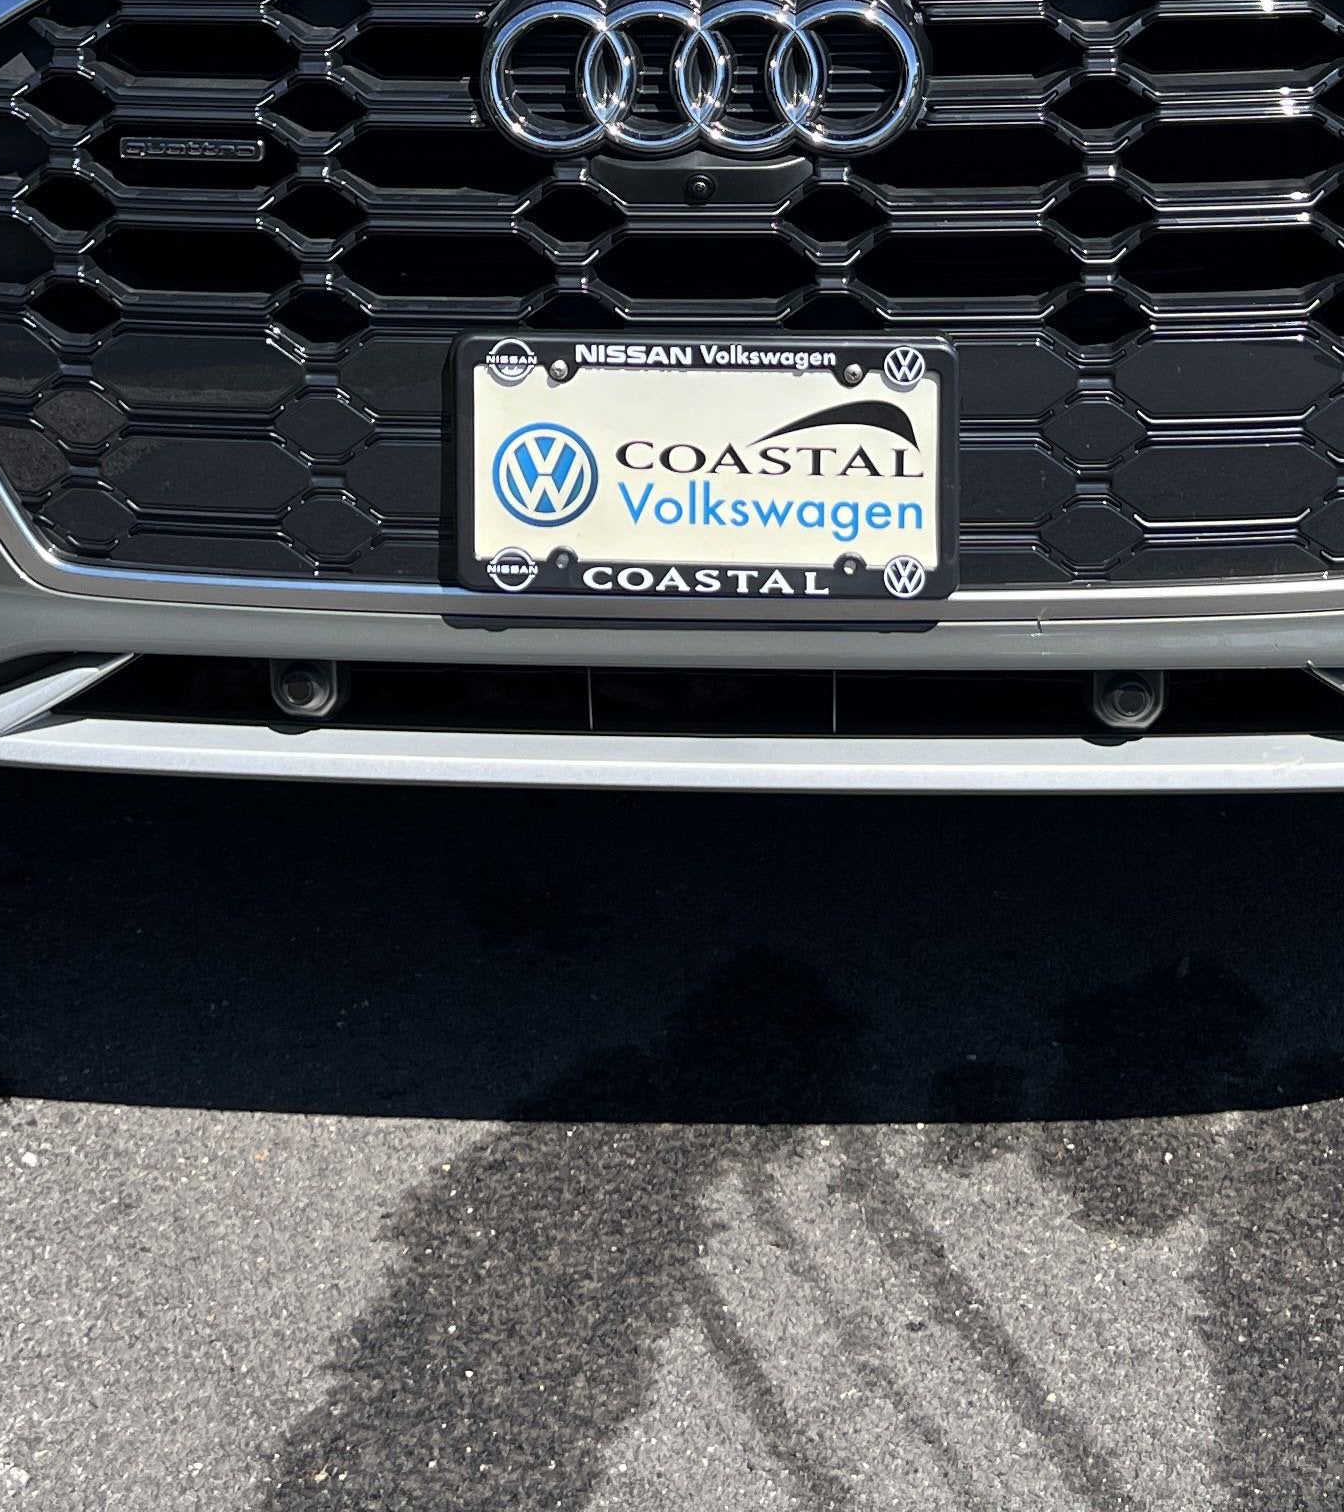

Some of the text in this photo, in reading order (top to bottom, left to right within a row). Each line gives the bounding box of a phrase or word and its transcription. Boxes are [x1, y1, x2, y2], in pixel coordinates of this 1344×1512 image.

[485, 355, 538, 365] NISSAN
[575, 344, 836, 370] NISSAN Volkswagen
[614, 441, 925, 479] COASTAL
[617, 479, 924, 543] Volkswagen
[486, 564, 539, 575] NISSAN
[582, 566, 830, 596] COASTAL
